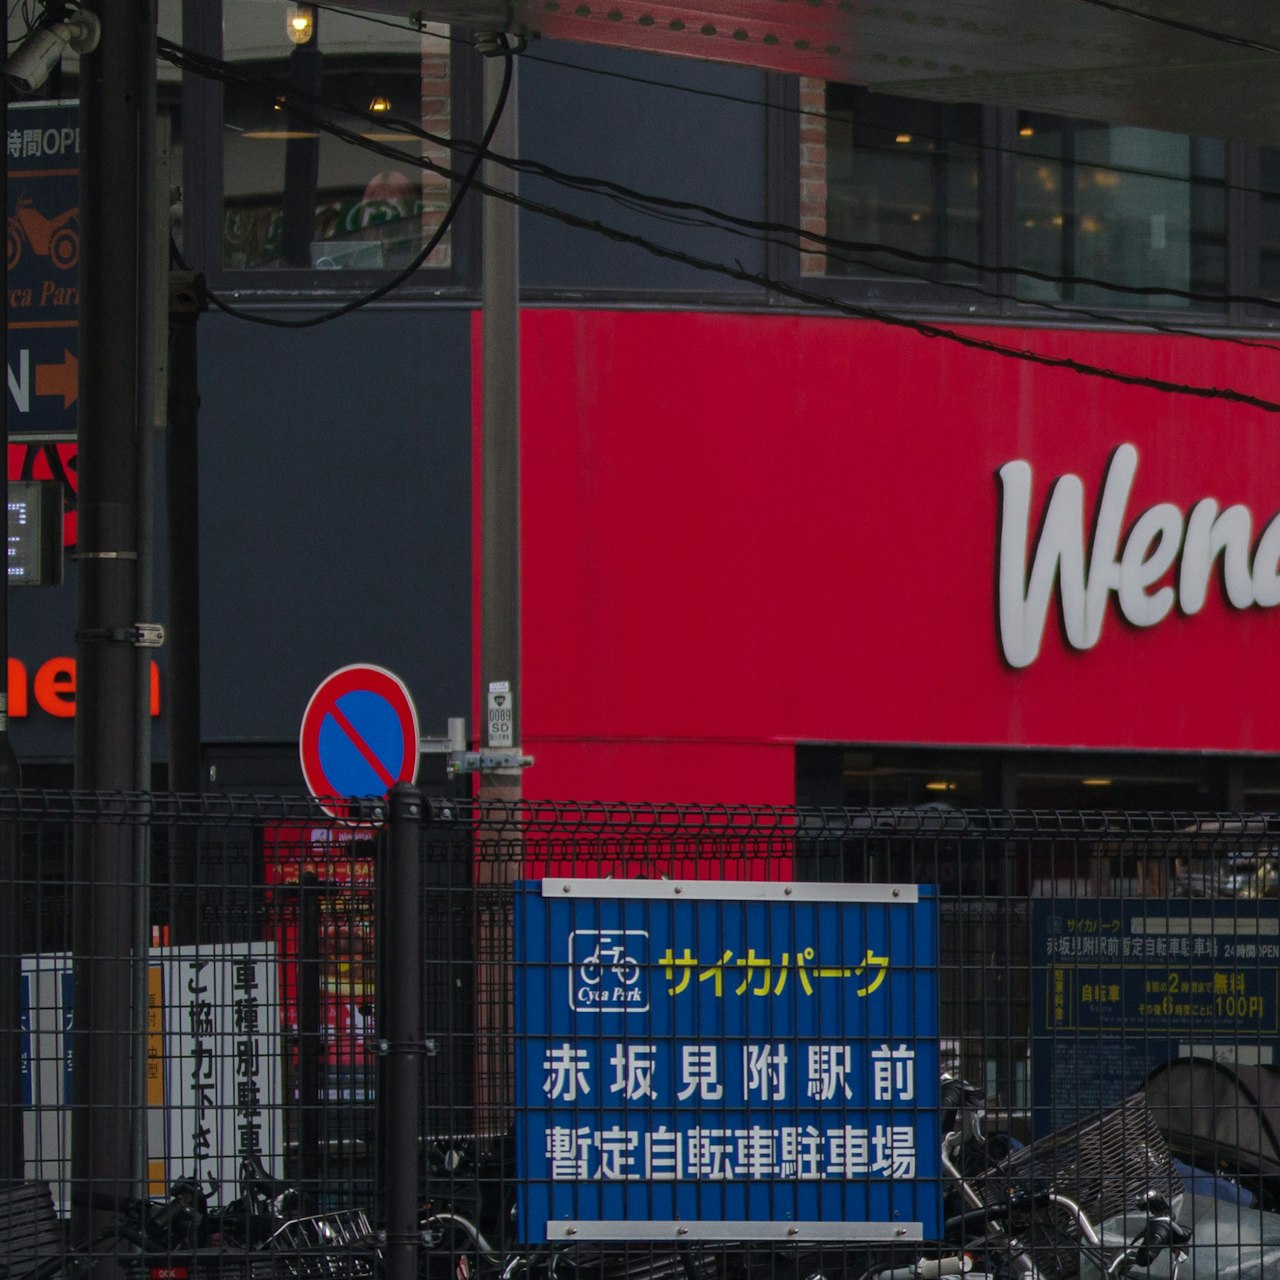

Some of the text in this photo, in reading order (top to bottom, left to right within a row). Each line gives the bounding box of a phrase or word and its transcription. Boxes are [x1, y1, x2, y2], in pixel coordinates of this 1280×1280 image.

[491, 723, 509, 733] SD
[658, 947, 889, 997] サイカパーク
[542, 1043, 916, 1102] 赤坂見附駅前
[544, 1125, 916, 1180] 暫定自転車駐車場
